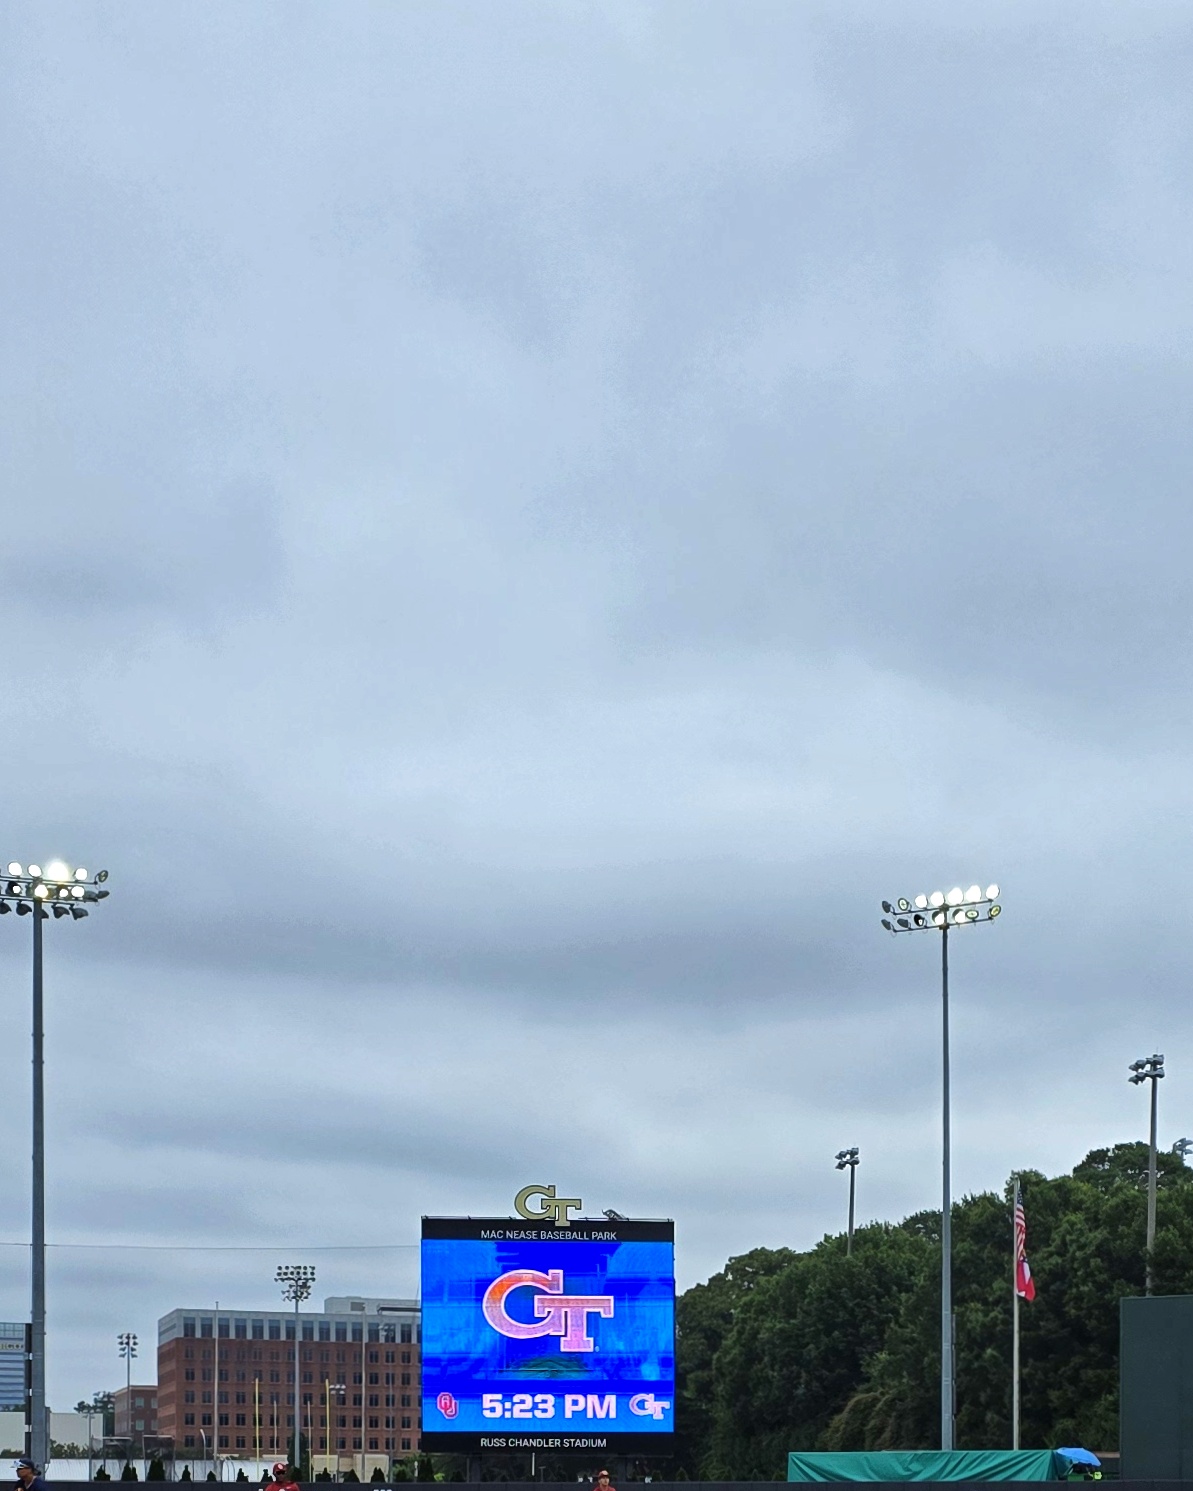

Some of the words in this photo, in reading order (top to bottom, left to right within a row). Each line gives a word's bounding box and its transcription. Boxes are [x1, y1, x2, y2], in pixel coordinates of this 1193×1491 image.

[481, 1230, 504, 1239] MAC
[506, 1230, 538, 1240] NEASE
[540, 1231, 589, 1240] BASEBALL
[591, 1232, 617, 1240] PARK
[482, 1269, 614, 1352] GT
[482, 1393, 556, 1419] 5:23
[564, 1394, 617, 1419] PM
[480, 1438, 507, 1448] RUSS
[508, 1438, 561, 1449] CHANDLER
[563, 1439, 607, 1449] STADIUM
